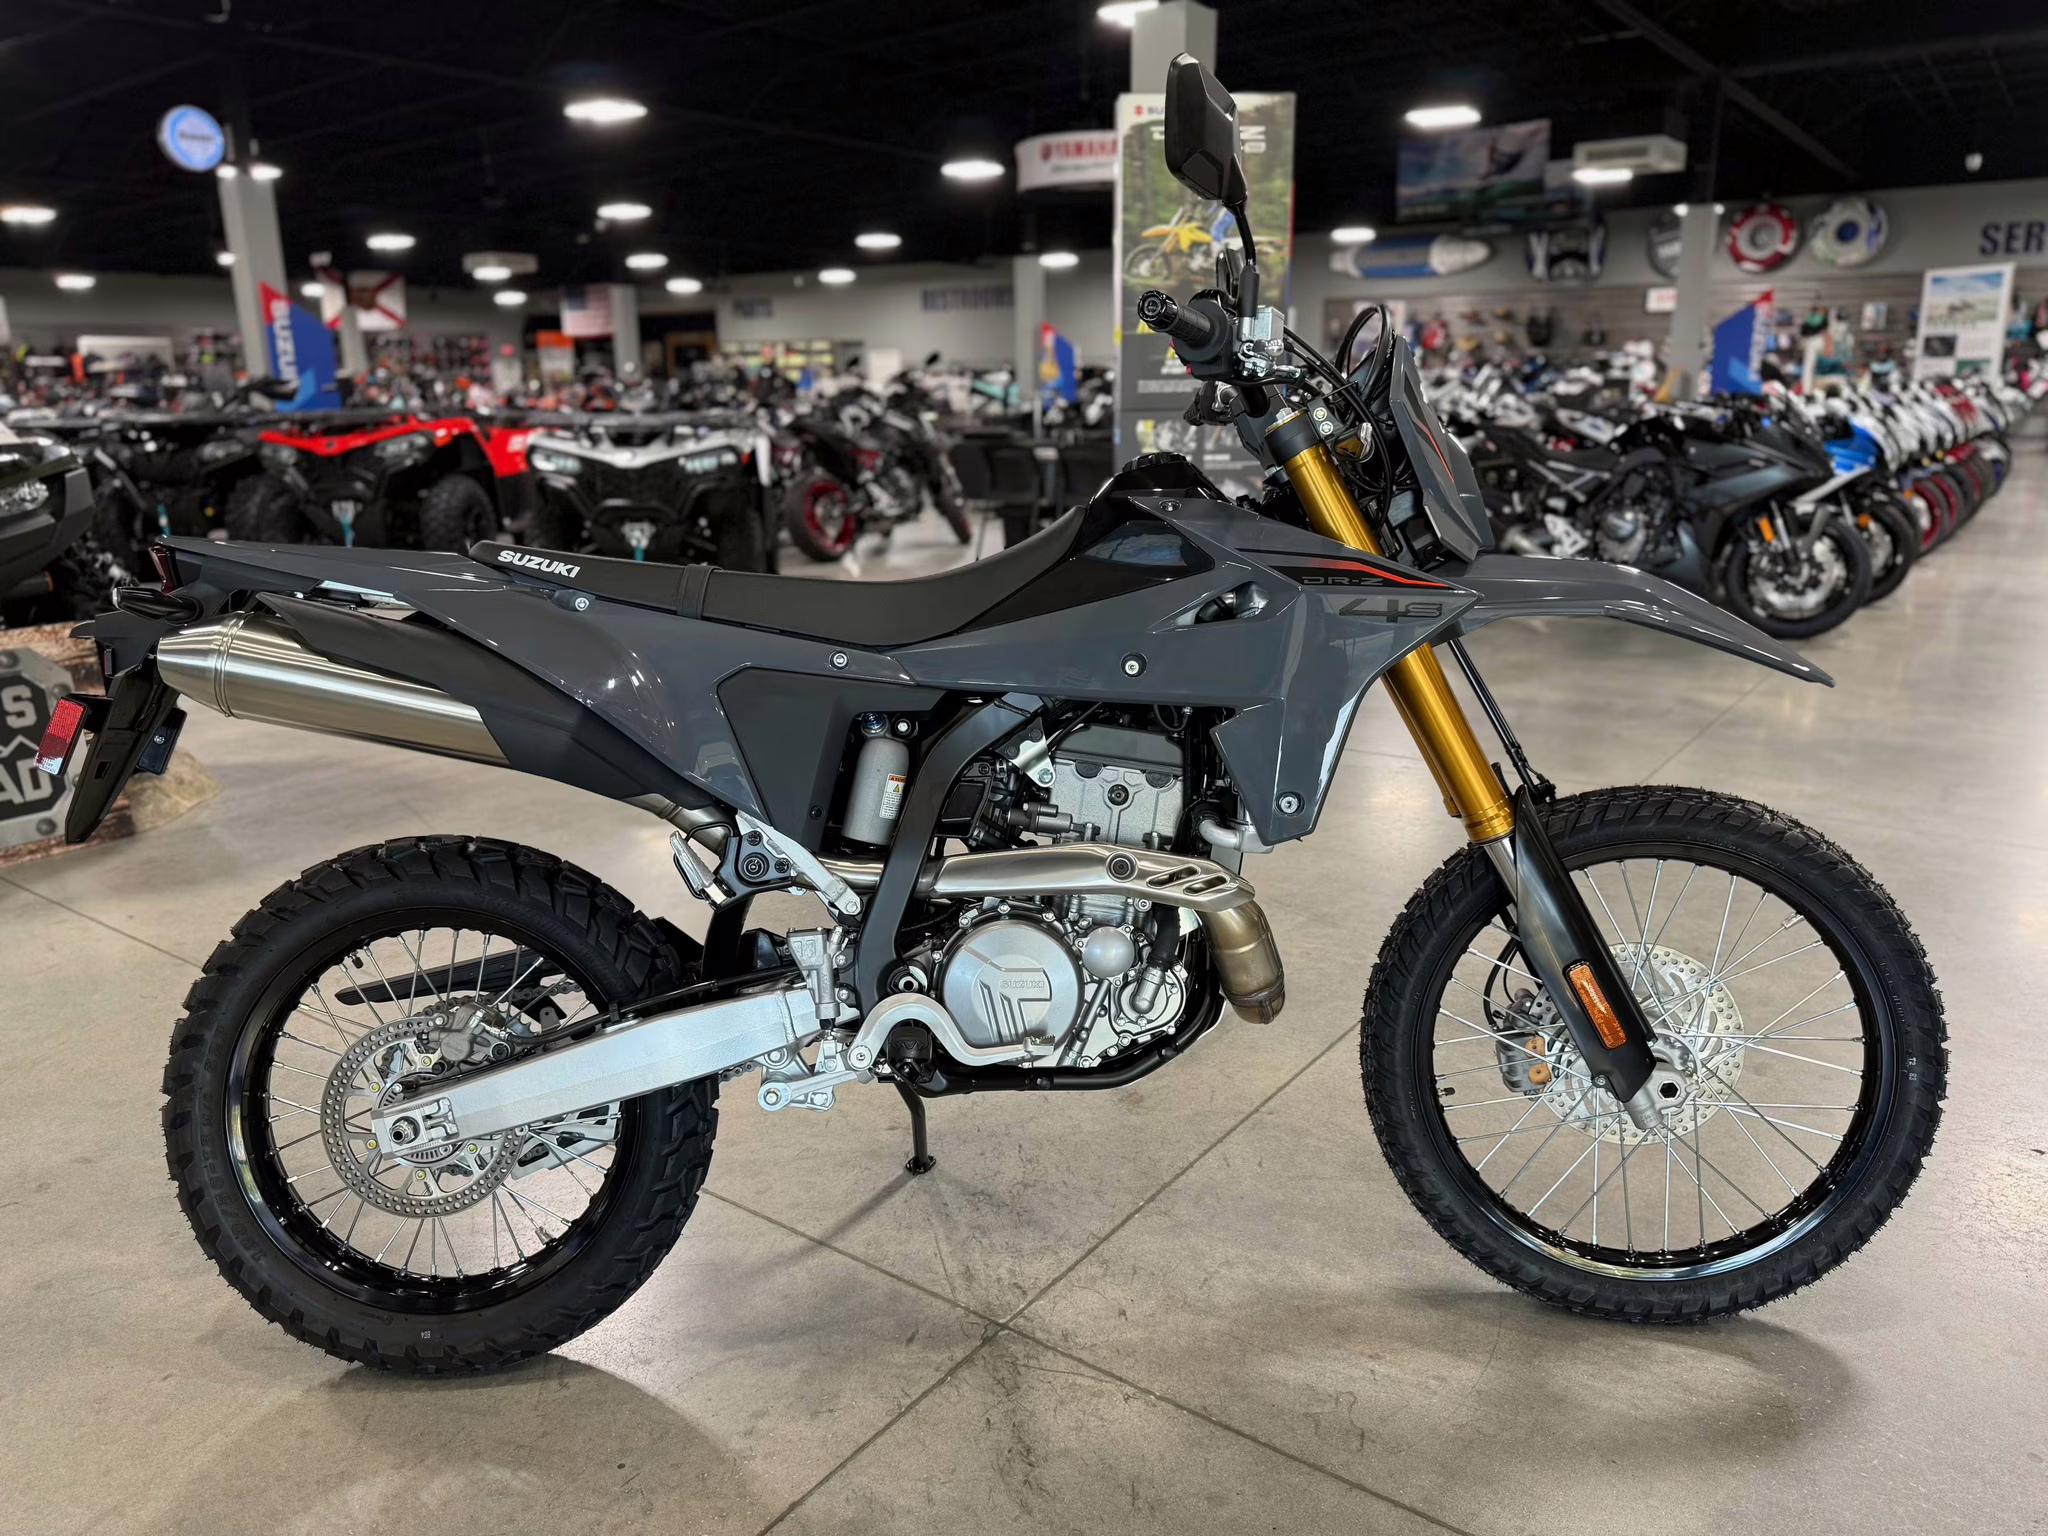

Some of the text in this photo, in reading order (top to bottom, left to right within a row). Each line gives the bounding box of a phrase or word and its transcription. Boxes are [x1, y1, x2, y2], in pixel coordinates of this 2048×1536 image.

[497, 550, 581, 578] SUZUKI
[1302, 576, 1383, 586] DR-Z
[1000, 980, 1044, 989] SUZUKI
